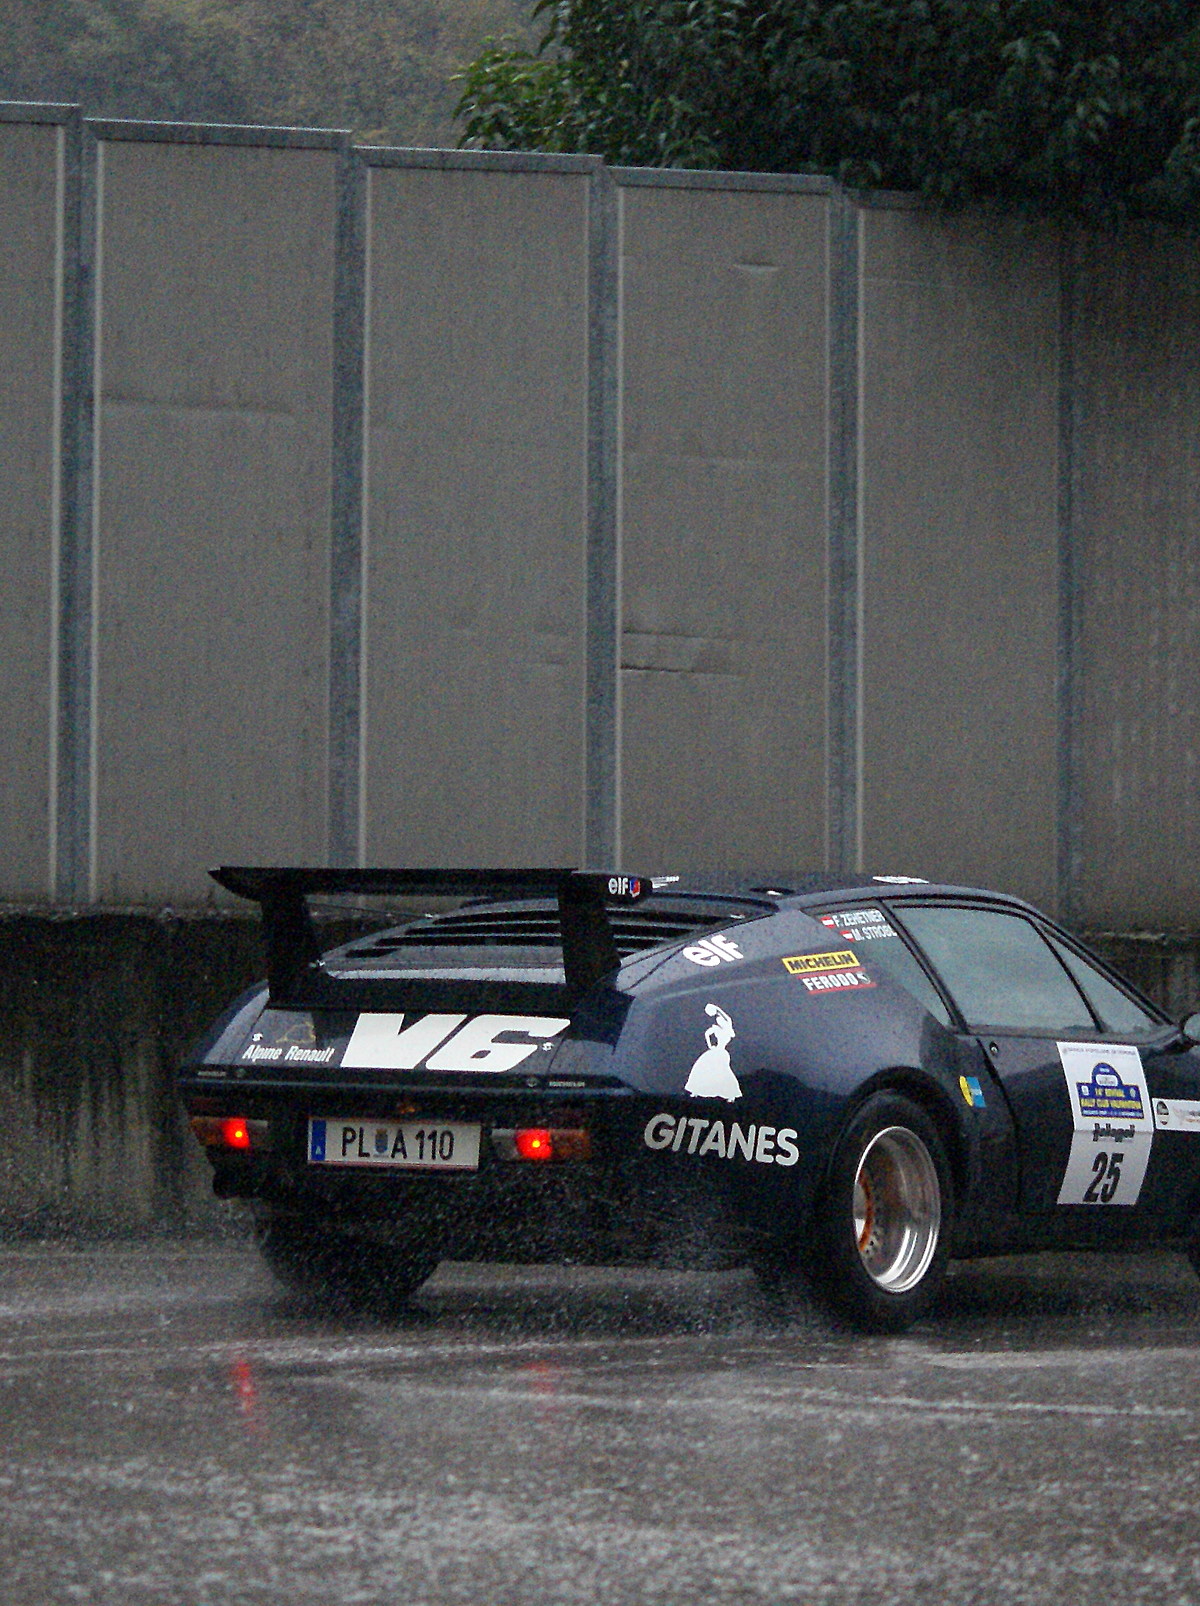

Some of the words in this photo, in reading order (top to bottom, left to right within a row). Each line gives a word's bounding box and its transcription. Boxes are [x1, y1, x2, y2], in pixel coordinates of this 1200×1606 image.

[608, 877, 628, 895] elf
[682, 934, 744, 967] elf
[787, 953, 856, 971] MICHELIN
[802, 972, 859, 991] FERODO
[242, 1044, 283, 1062] Alpine
[284, 1045, 335, 1062] Renault
[340, 1013, 571, 1073] V6
[644, 1113, 799, 1167] GITANES
[1082, 1151, 1125, 1203] 25
